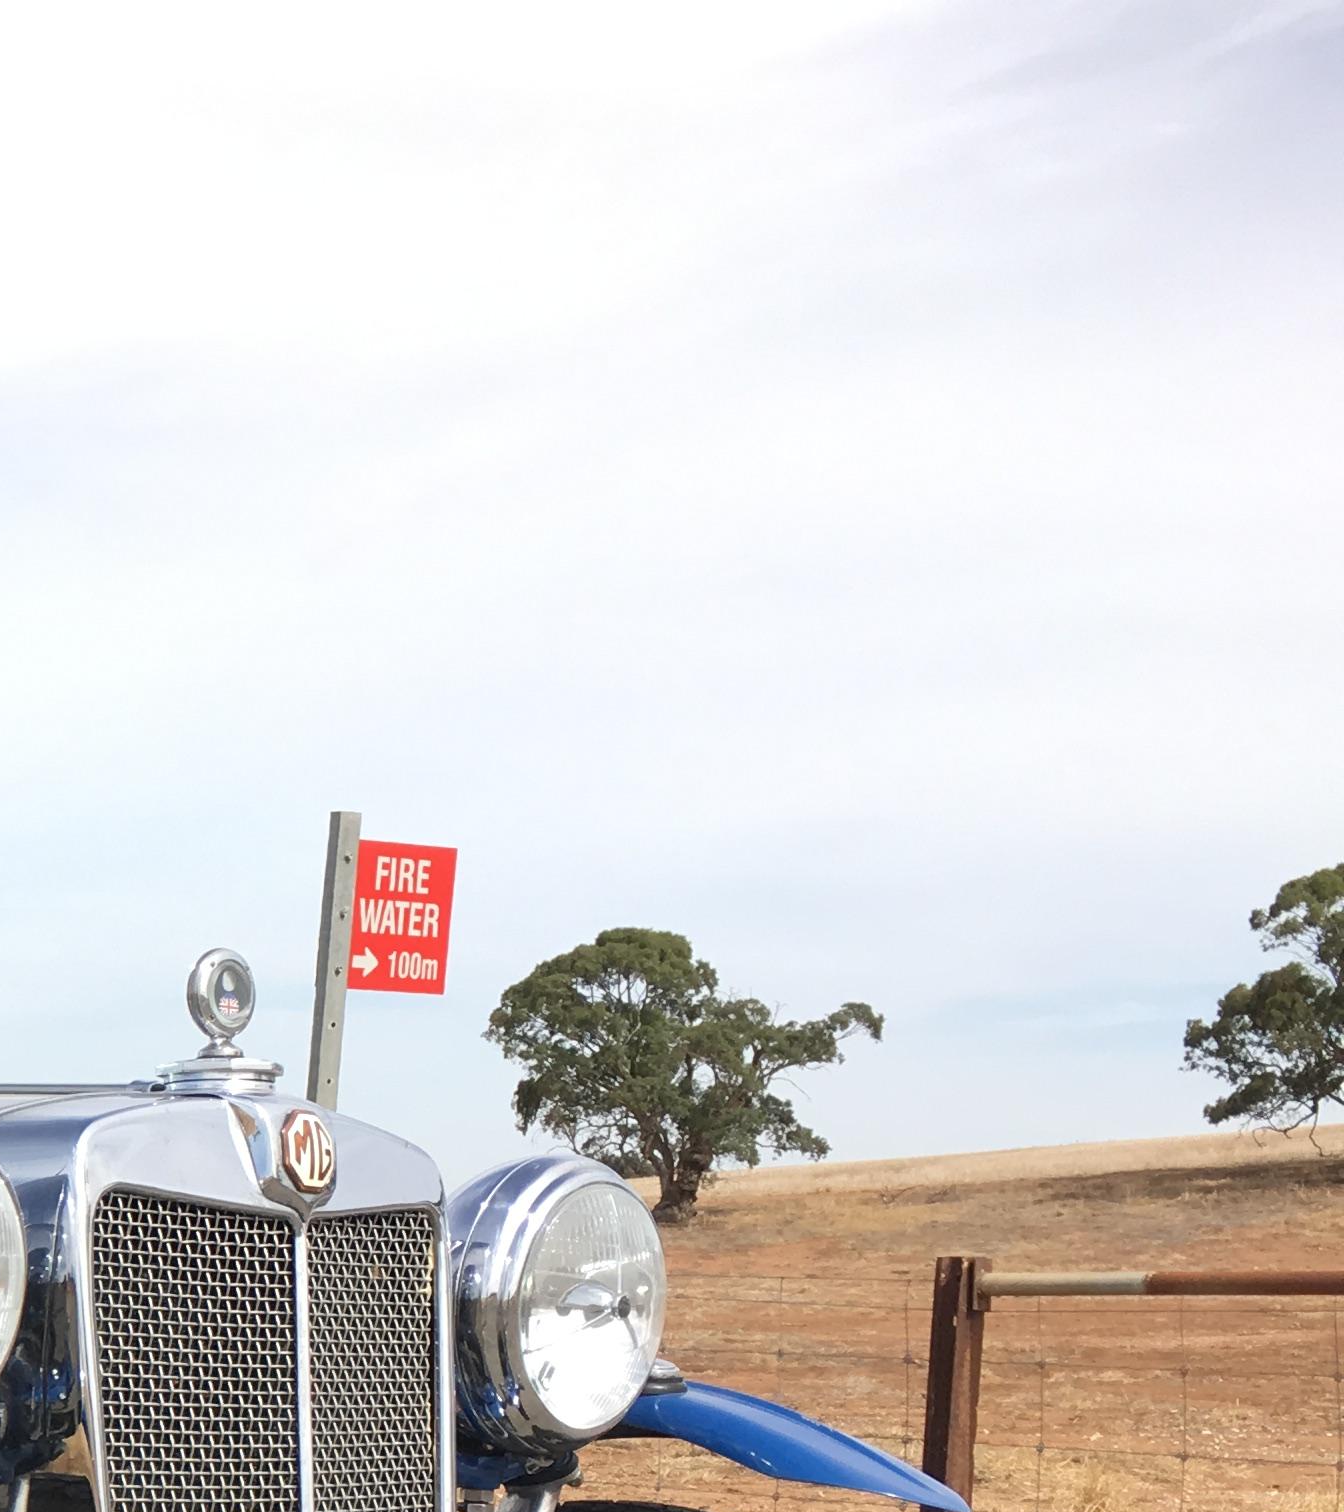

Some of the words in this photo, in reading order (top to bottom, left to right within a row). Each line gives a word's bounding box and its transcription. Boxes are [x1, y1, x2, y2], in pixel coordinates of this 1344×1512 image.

[375, 855, 432, 895] FIRE
[359, 897, 440, 938] WATER
[387, 951, 438, 981] 100m
[292, 1118, 332, 1182] MG
